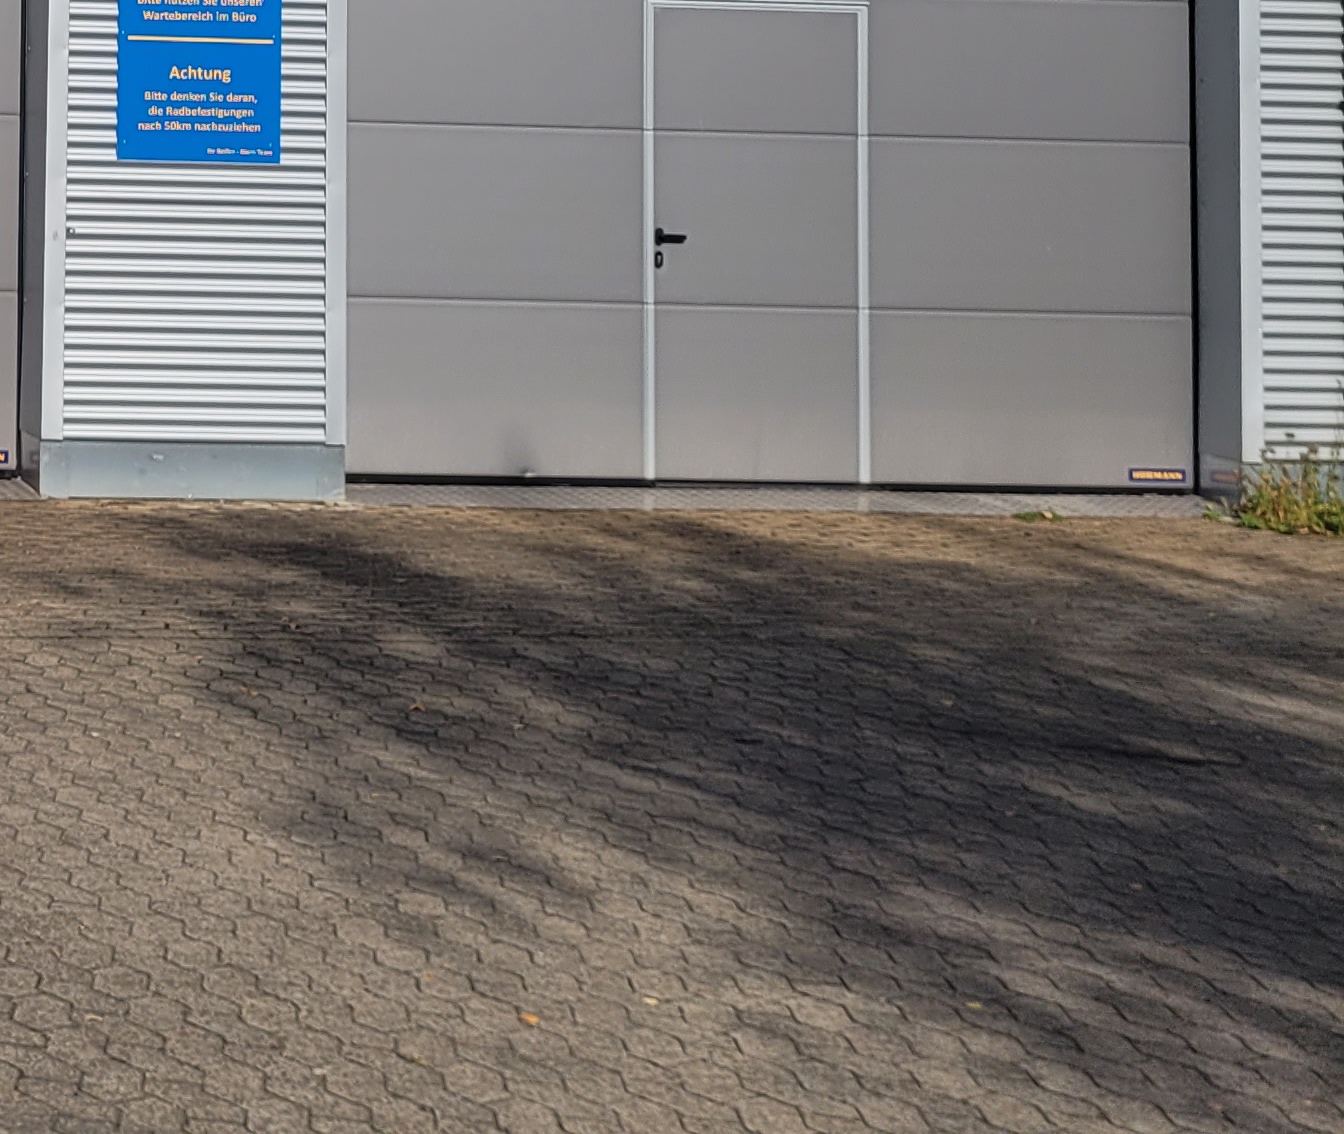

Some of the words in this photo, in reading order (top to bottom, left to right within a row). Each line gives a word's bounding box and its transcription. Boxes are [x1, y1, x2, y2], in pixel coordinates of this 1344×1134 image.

[143, 10, 213, 21] Wartebereich
[216, 11, 229, 21] im
[232, 11, 257, 22] Büro
[169, 65, 231, 83] Achtung
[144, 91, 168, 101] Bitte
[170, 91, 206, 102] denken
[209, 92, 224, 102] Sie
[226, 93, 258, 104] daran,
[148, 106, 163, 116] die
[166, 106, 255, 119] Radbefestigungen
[138, 121, 162, 130] nach
[164, 121, 192, 131] 50km
[194, 122, 261, 133] nachzuziehen
